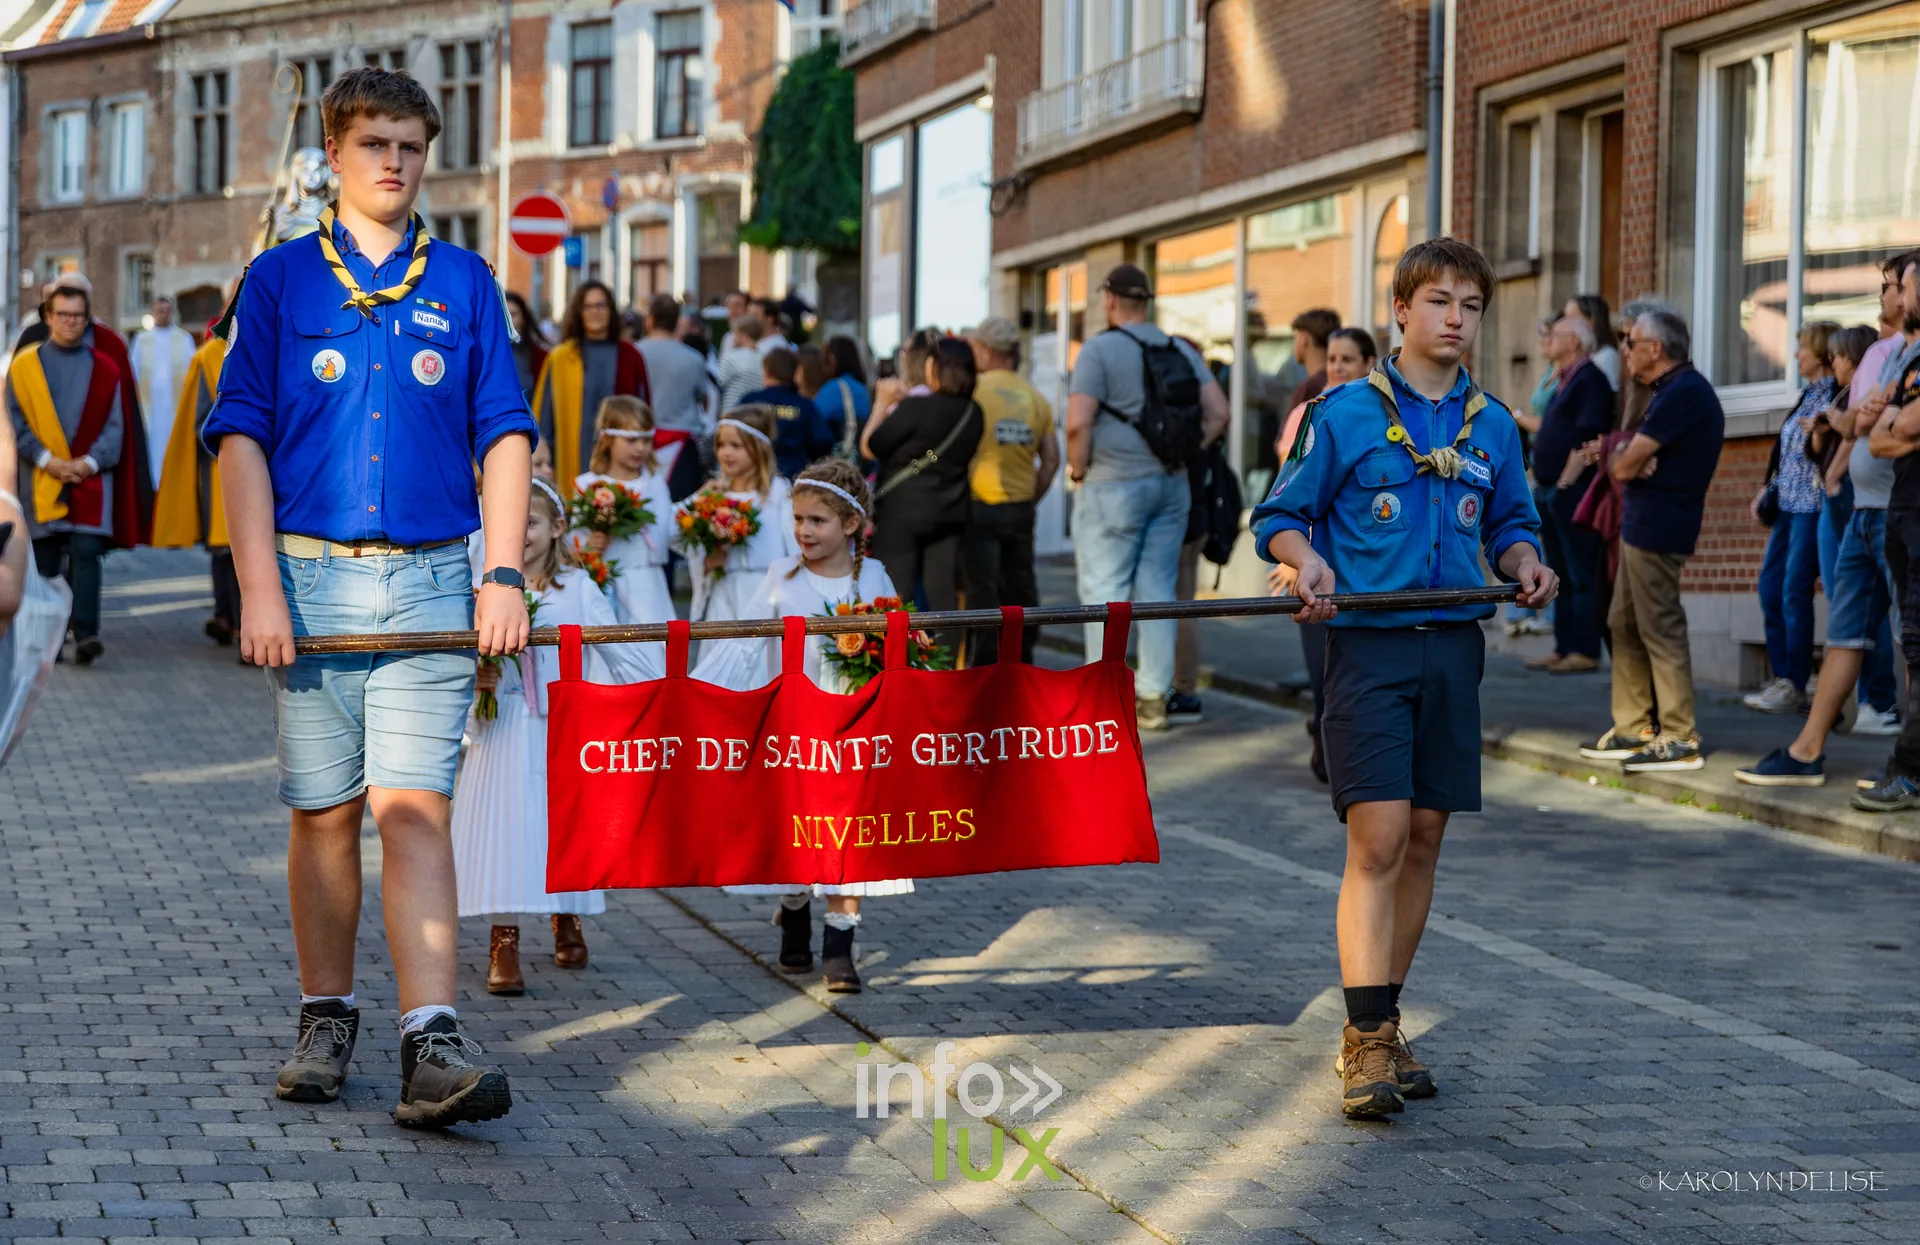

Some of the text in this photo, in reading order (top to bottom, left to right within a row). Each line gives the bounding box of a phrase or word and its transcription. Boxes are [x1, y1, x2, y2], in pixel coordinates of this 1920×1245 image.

[416, 311, 445, 328] Nanuk
[579, 720, 1120, 774] CHEF DE SAINTE GERTRUDE
[792, 808, 977, 850] NIVELLES
